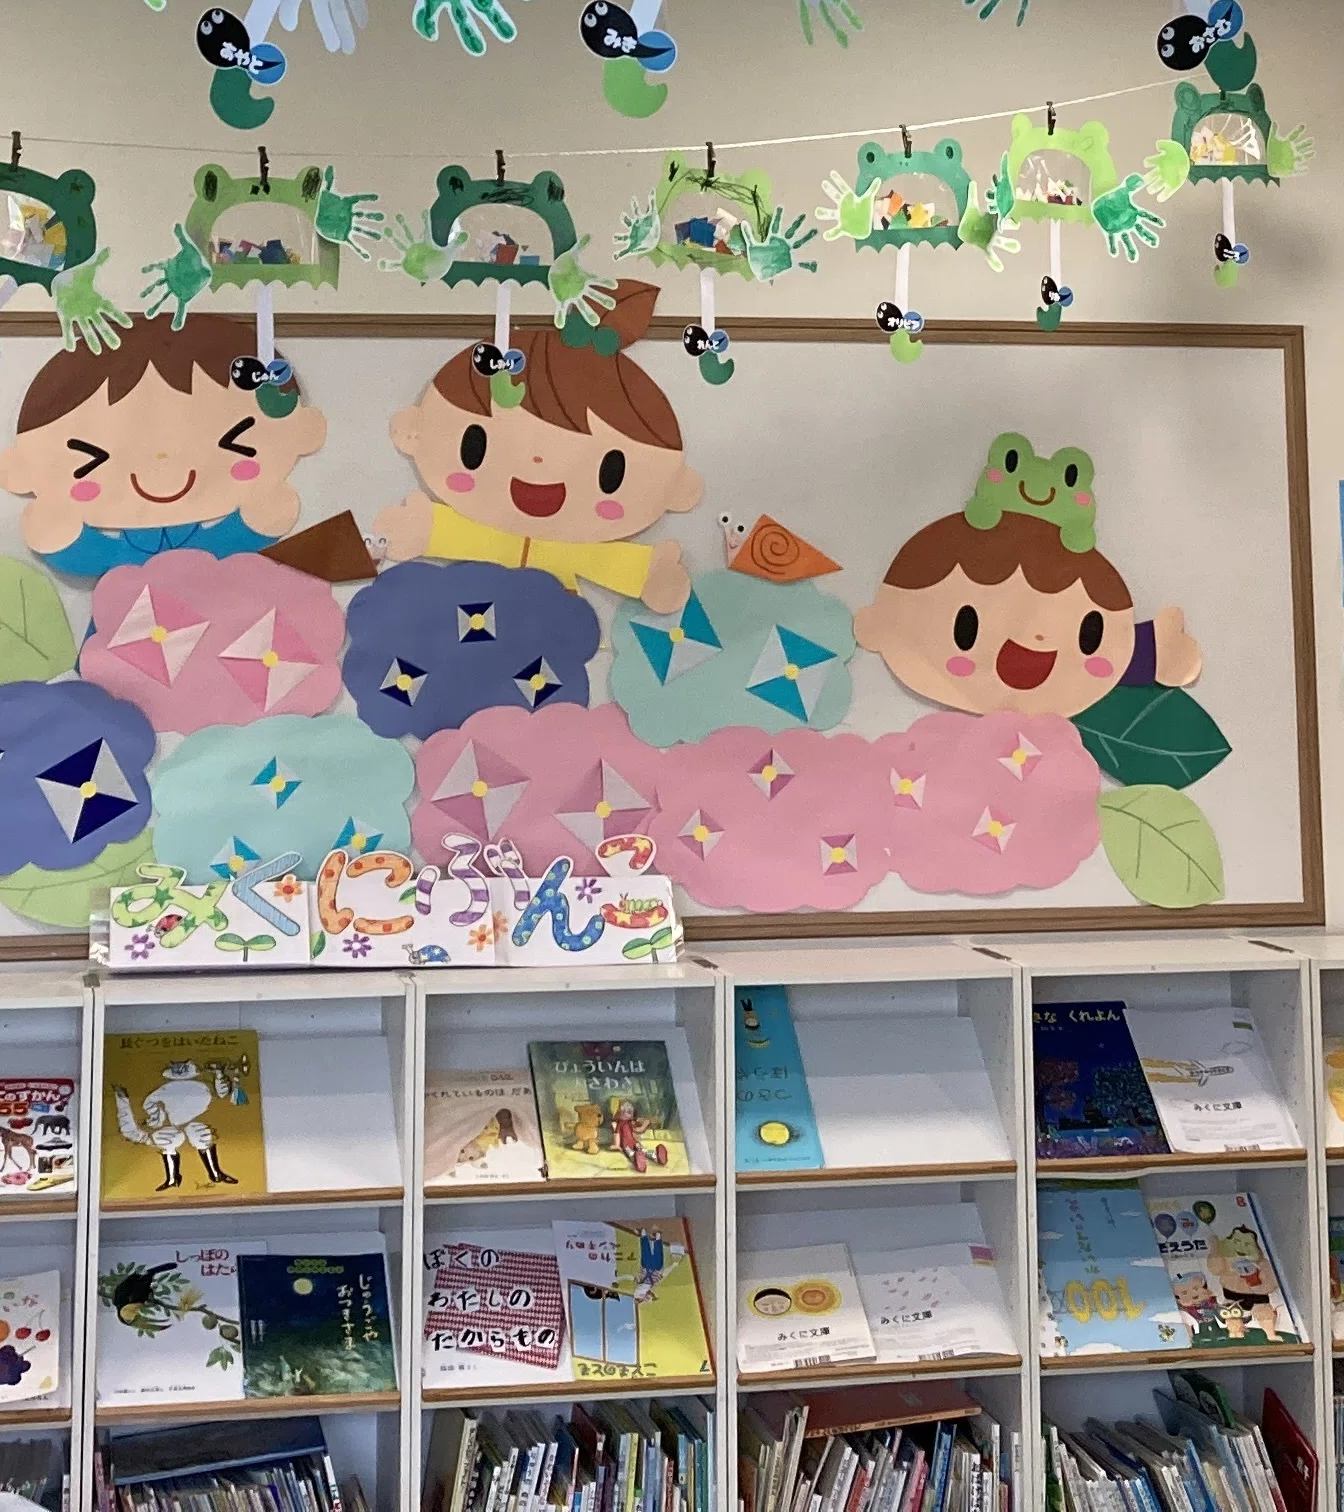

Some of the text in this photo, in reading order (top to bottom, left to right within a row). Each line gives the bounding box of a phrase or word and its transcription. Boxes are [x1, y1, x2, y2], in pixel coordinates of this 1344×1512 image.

[603, 27, 638, 54] みき
[218, 41, 264, 75] あやと
[109, 833, 672, 953] みくにぶんこ
[1067, 1008, 1121, 1024] くれよん
[1193, 1100, 1243, 1113] みくに文庫
[175, 1248, 230, 1264] しっぽの
[423, 1248, 500, 1270] ぼくの
[588, 1251, 637, 1263] アニカの
[427, 1288, 533, 1310] わたしの
[1064, 1276, 1146, 1324] 100
[879, 1309, 934, 1326] みくに文庫
[430, 1327, 558, 1352] たからもの
[777, 1326, 831, 1343] みくに文庫
